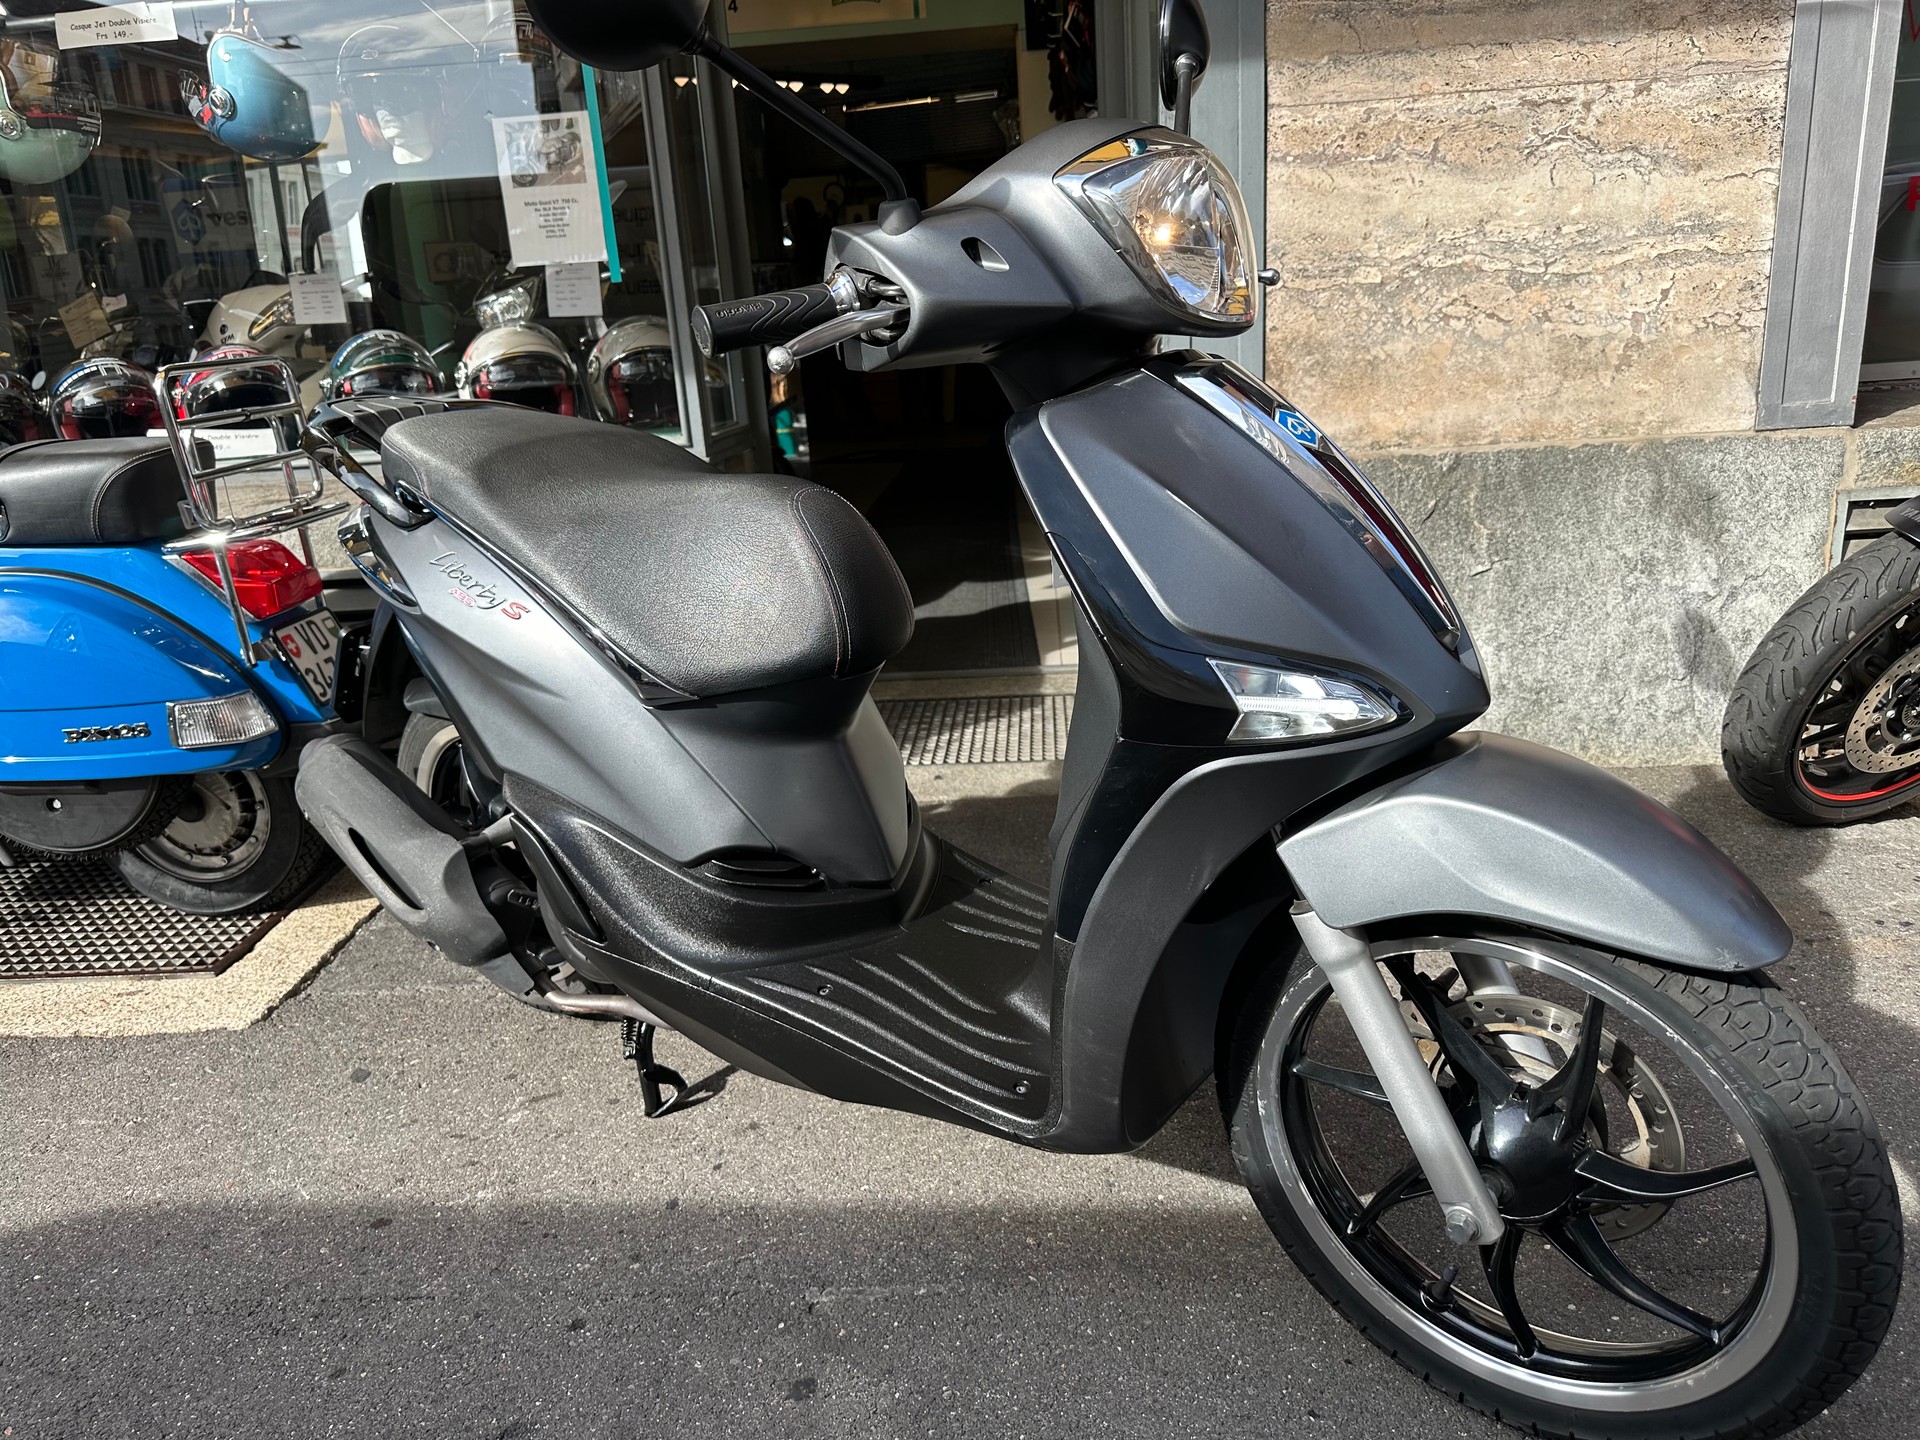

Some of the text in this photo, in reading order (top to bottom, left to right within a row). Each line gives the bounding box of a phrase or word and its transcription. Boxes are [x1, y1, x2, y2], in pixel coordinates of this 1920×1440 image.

[70, 23, 92, 31] Casque
[95, 20, 106, 28] Jet
[108, 18, 132, 27] Double
[96, 30, 134, 40] Frs 149.-
[429, 551, 531, 620] Liberty S
[448, 587, 476, 607] ABS
[294, 620, 330, 655] VD
